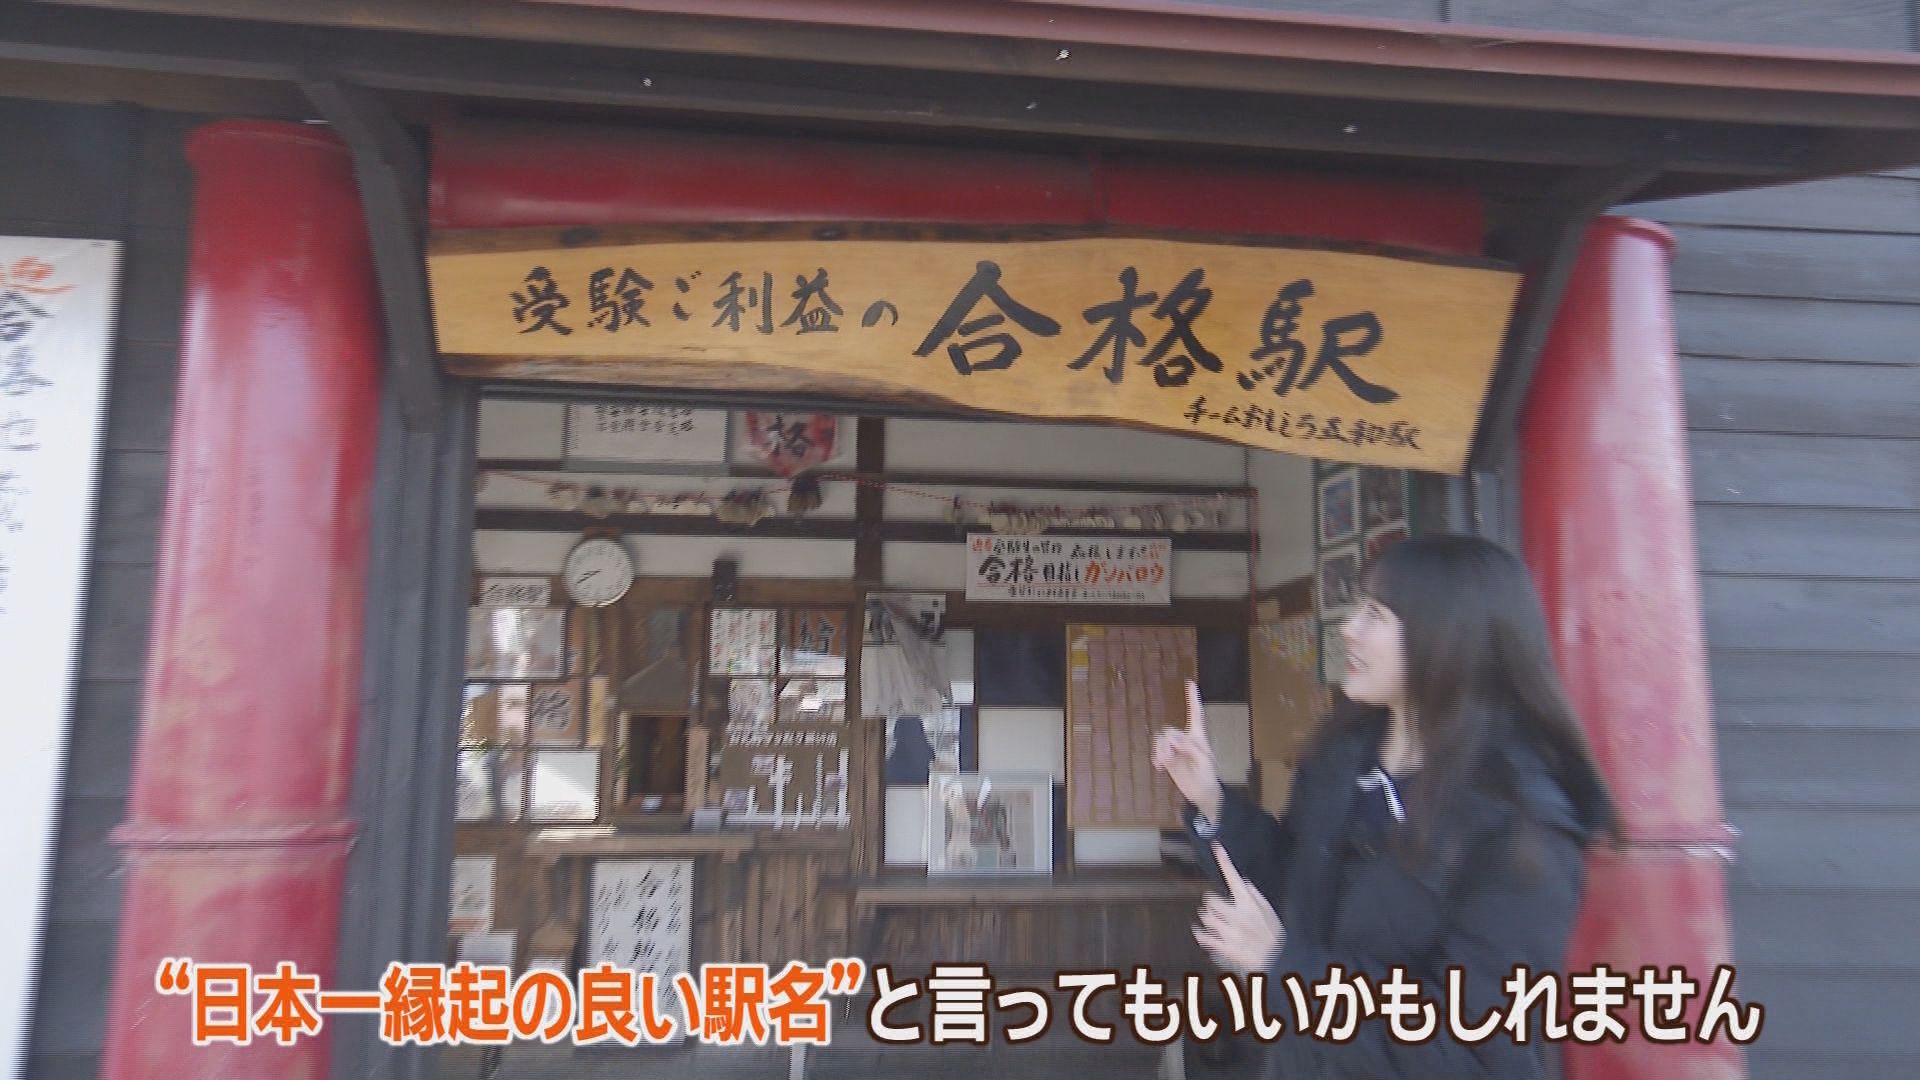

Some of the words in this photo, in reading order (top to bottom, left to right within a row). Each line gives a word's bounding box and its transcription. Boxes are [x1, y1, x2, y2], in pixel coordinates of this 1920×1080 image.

[510, 264, 899, 335] 受験ご利益の
[913, 259, 1398, 404] 合格駅
